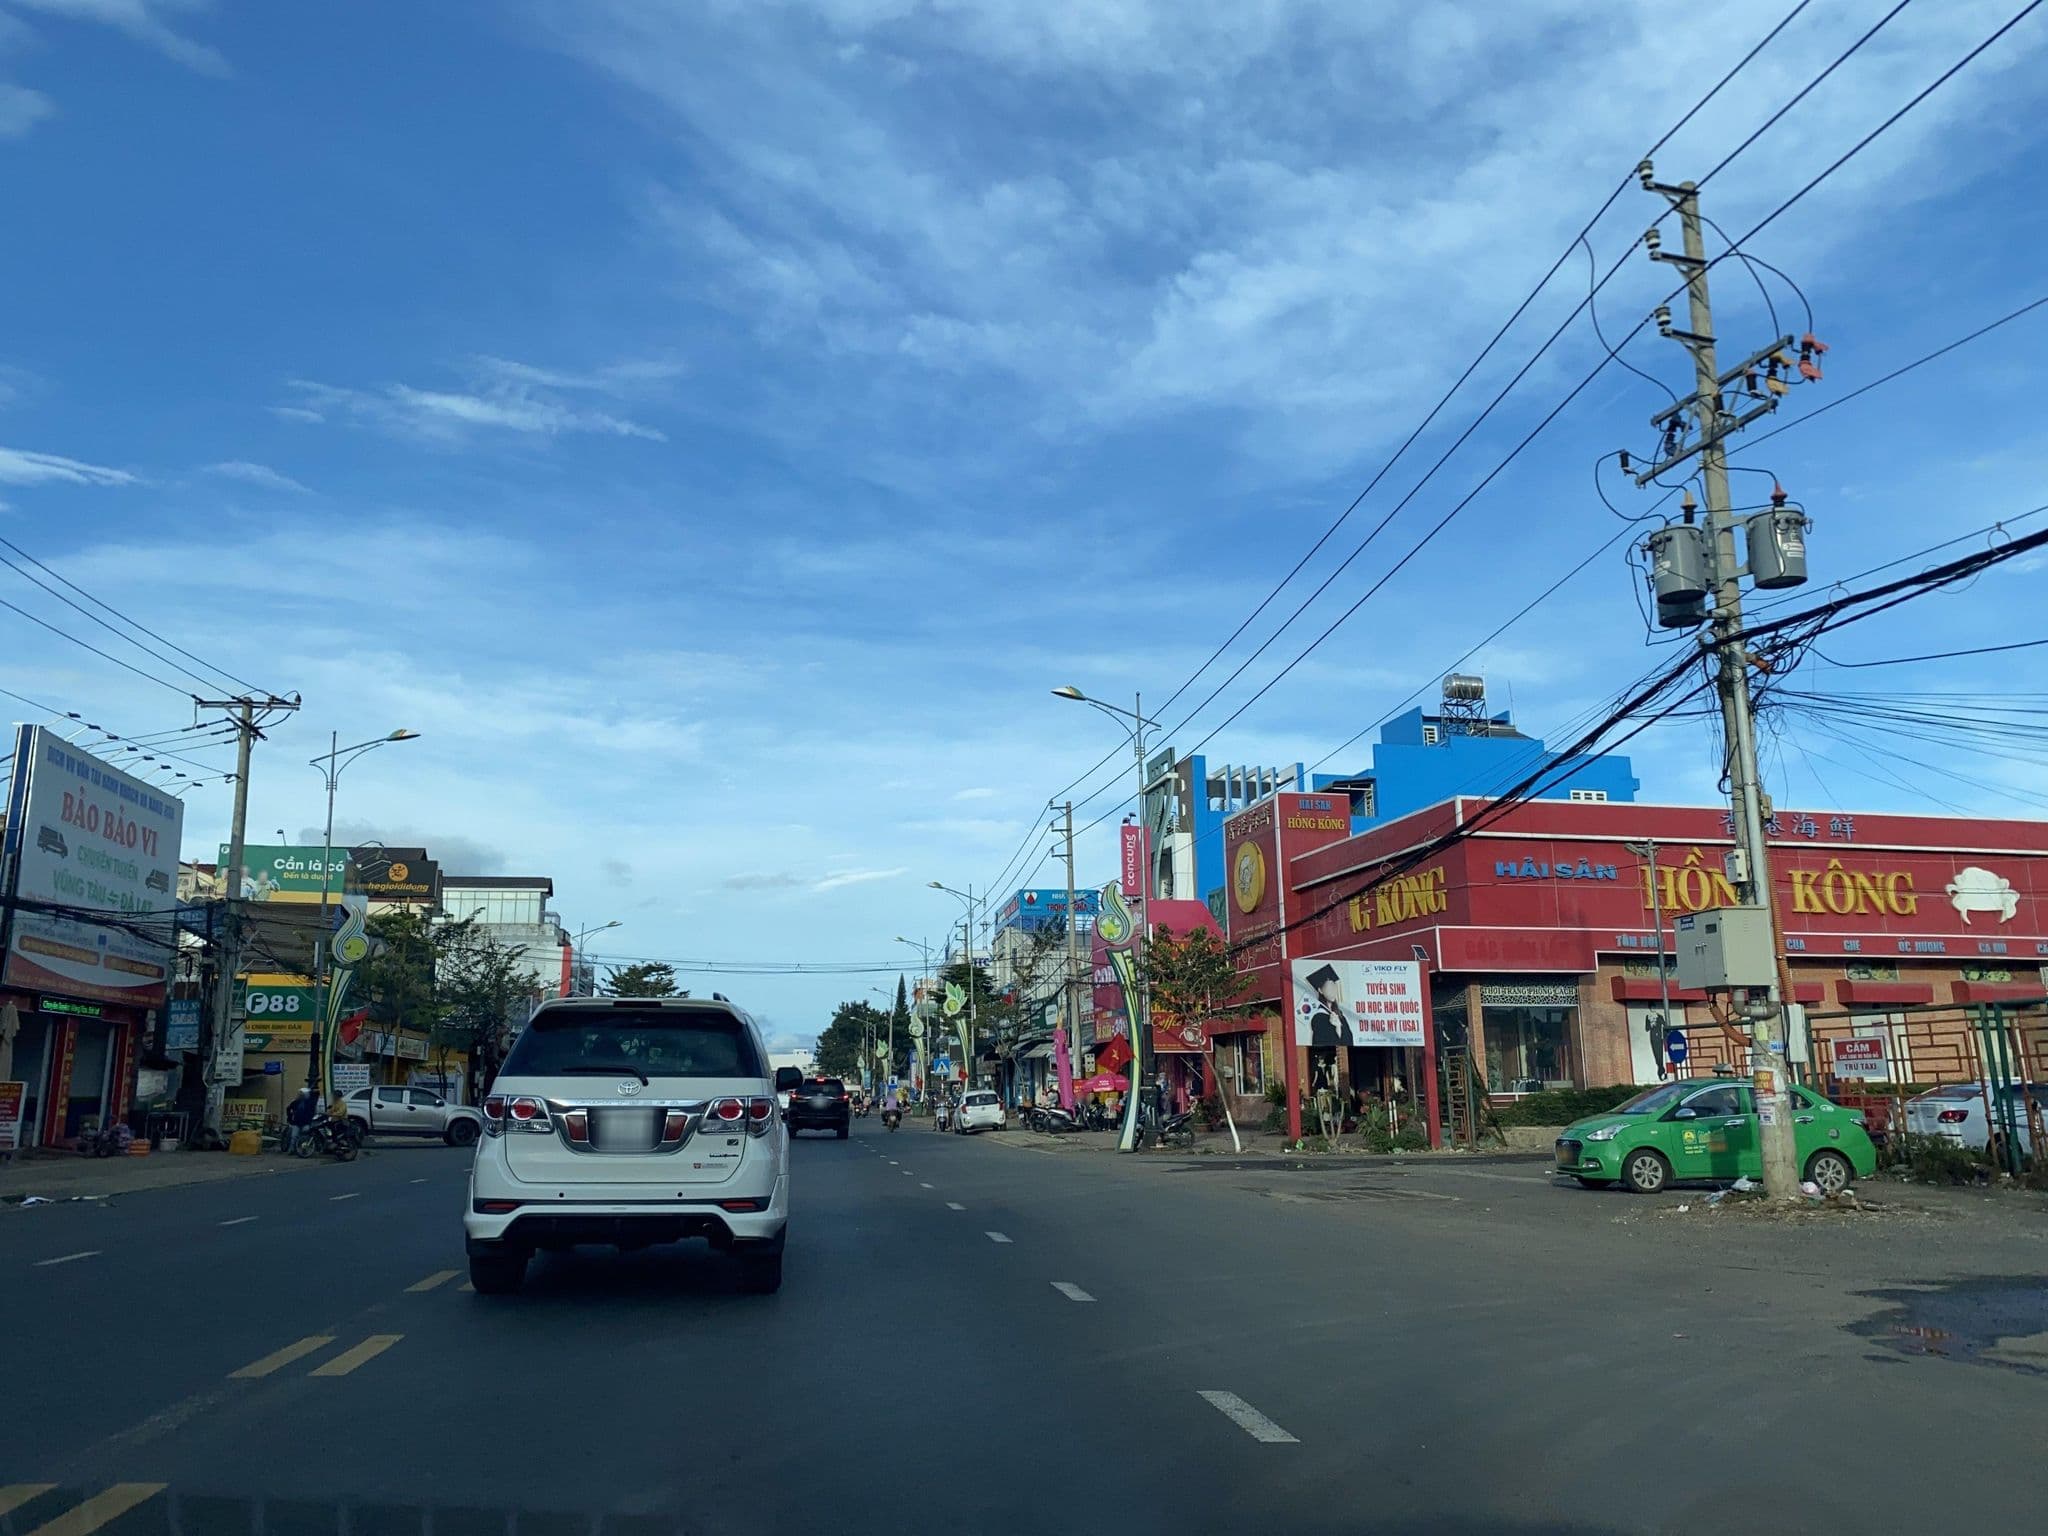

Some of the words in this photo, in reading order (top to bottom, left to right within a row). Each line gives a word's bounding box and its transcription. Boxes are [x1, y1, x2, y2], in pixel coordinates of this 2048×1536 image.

[61, 785, 99, 833] BẢO
[102, 805, 137, 849] BẢO
[141, 826, 158, 857] VI
[1287, 812, 1316, 829] HỒNG
[1318, 816, 1345, 830] KÔNG
[274, 856, 304, 870] Cần
[309, 859, 322, 871] là
[328, 860, 345, 872] có
[1125, 833, 1137, 887] concung
[1495, 856, 1550, 879] HẢI
[1555, 856, 1619, 881] SẢN
[53, 867, 85, 897] VŨNG
[301, 871, 309, 880] là
[311, 872, 334, 883] duyt
[1641, 846, 1738, 911] HỒN
[1787, 857, 1919, 916] KÔNG
[1376, 866, 1448, 928] KÔNG
[1786, 938, 1806, 950] CUA
[1366, 979, 1388, 995] TUYỂN
[1389, 983, 1407, 995] SINH
[246, 992, 300, 1014] F88
[1356, 1001, 1366, 1014] DU
[1368, 1001, 1382, 1016] HỌC
[1384, 998, 1398, 1014] HÀN
[1400, 997, 1419, 1015] QUỐC
[1359, 1020, 1369, 1032] DU
[1371, 1020, 1385, 1034] HỌC
[1387, 1017, 1397, 1032] MỸ
[1860, 1062, 1877, 1070] TAXI
